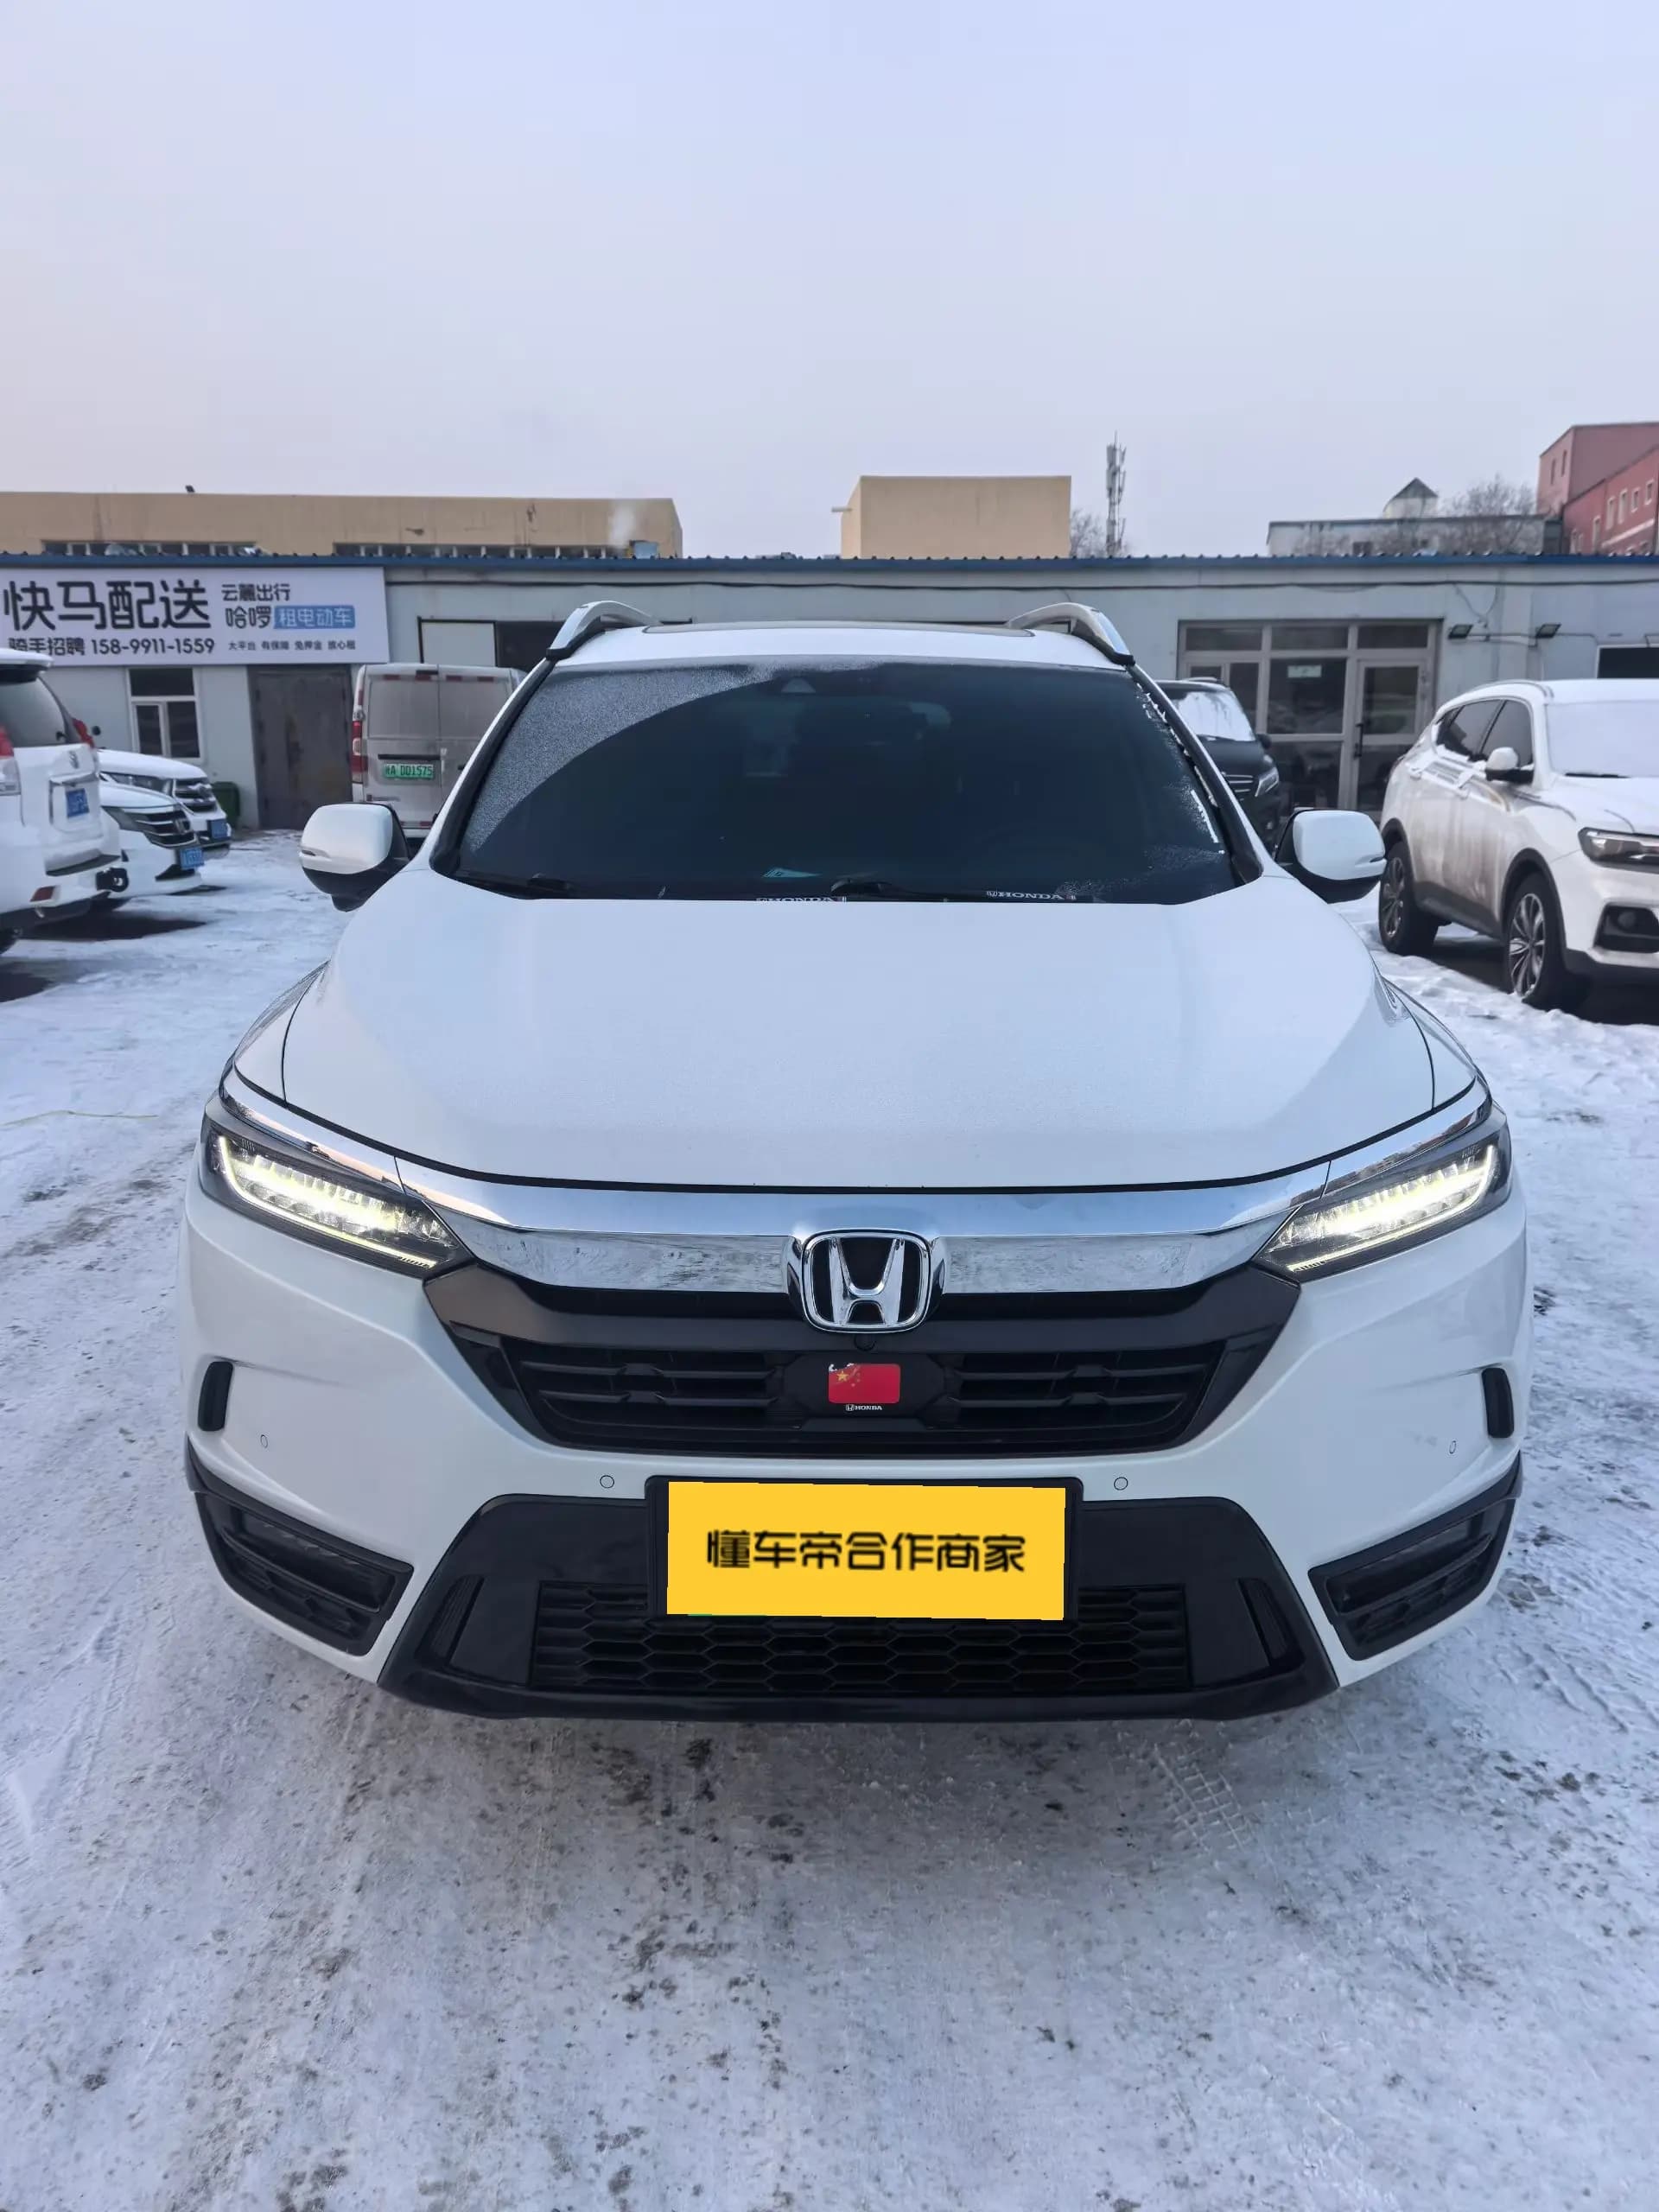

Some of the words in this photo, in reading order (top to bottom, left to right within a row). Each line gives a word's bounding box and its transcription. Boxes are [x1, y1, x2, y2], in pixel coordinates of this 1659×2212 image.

[3, 580, 212, 631] 快马配送
[225, 606, 271, 629] 哈啰
[278, 607, 353, 627] 租电动车
[92, 638, 215, 655] 158-9911-1559
[998, 891, 1065, 900] HONDA
